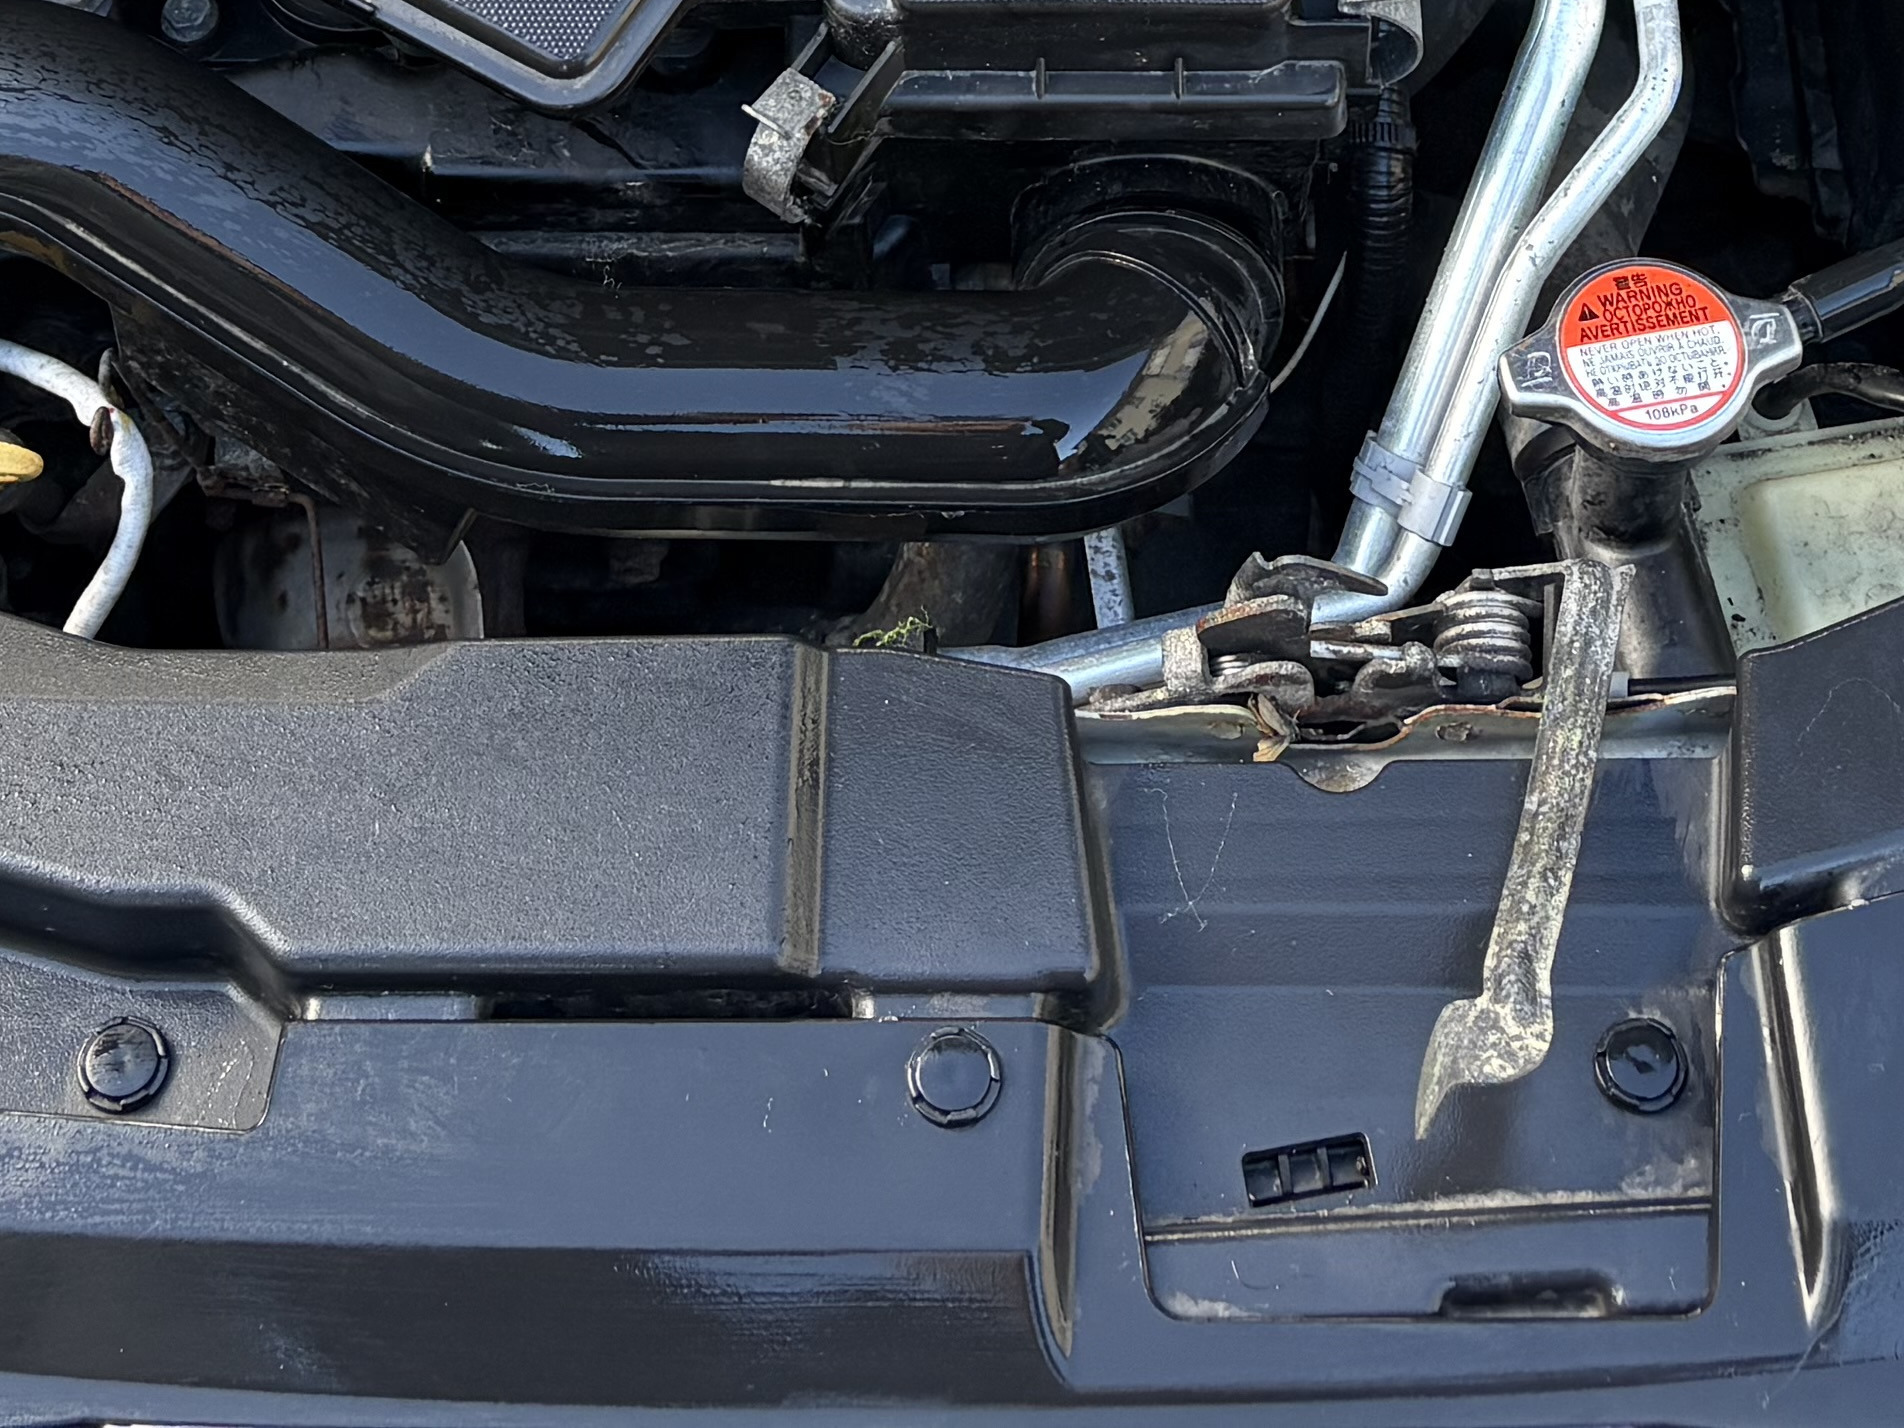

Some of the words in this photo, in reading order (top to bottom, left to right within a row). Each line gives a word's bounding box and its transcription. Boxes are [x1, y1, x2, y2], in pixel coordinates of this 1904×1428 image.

[1596, 281, 1683, 309] WARNING
[1613, 272, 1648, 291] 警告
[1601, 294, 1697, 322] ОСТОРОЖНО
[1578, 306, 1710, 342] AVERTISSEMENT
[1579, 342, 1618, 356] NEVER
[1621, 336, 1652, 349] OPEN
[1656, 329, 1689, 343] WHEN
[1644, 402, 1699, 421] 108kPa
